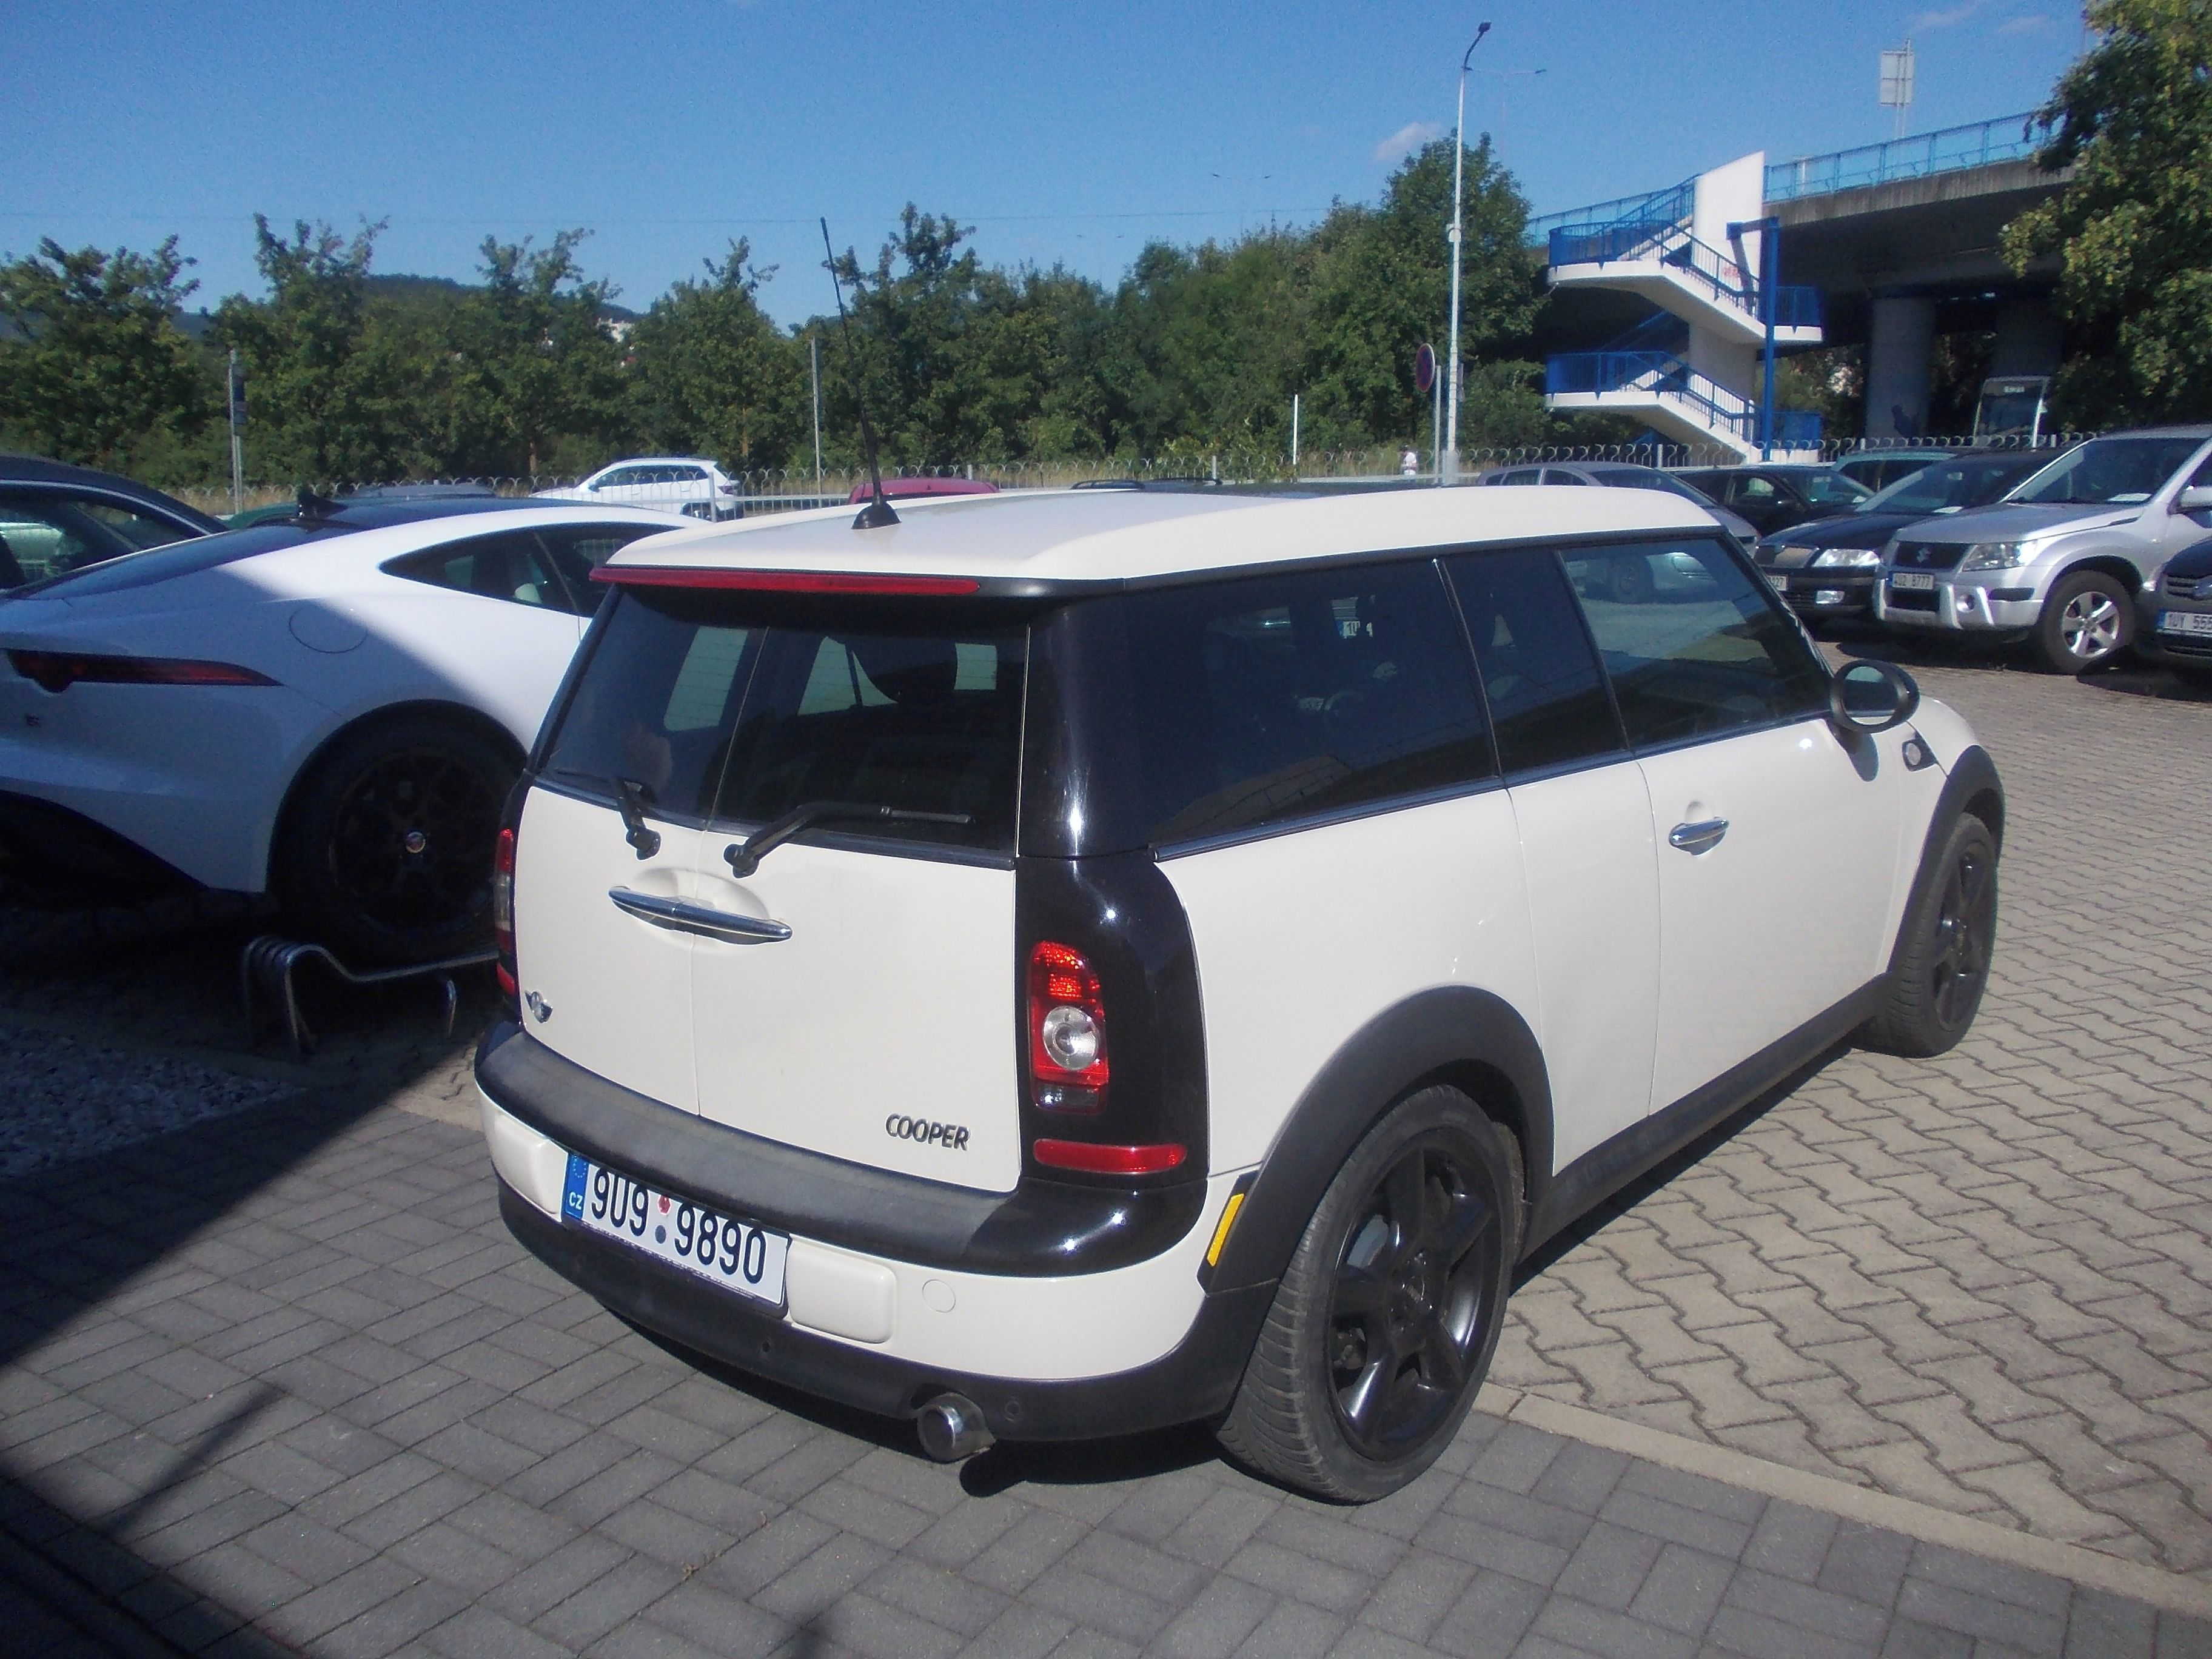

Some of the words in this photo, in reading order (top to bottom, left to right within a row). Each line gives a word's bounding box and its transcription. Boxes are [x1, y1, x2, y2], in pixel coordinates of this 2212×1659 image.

[885, 1113, 970, 1151] COOPER
[569, 1191, 583, 1210] CZ
[591, 1167, 649, 1236] 9U9
[674, 1202, 766, 1284] 9890
